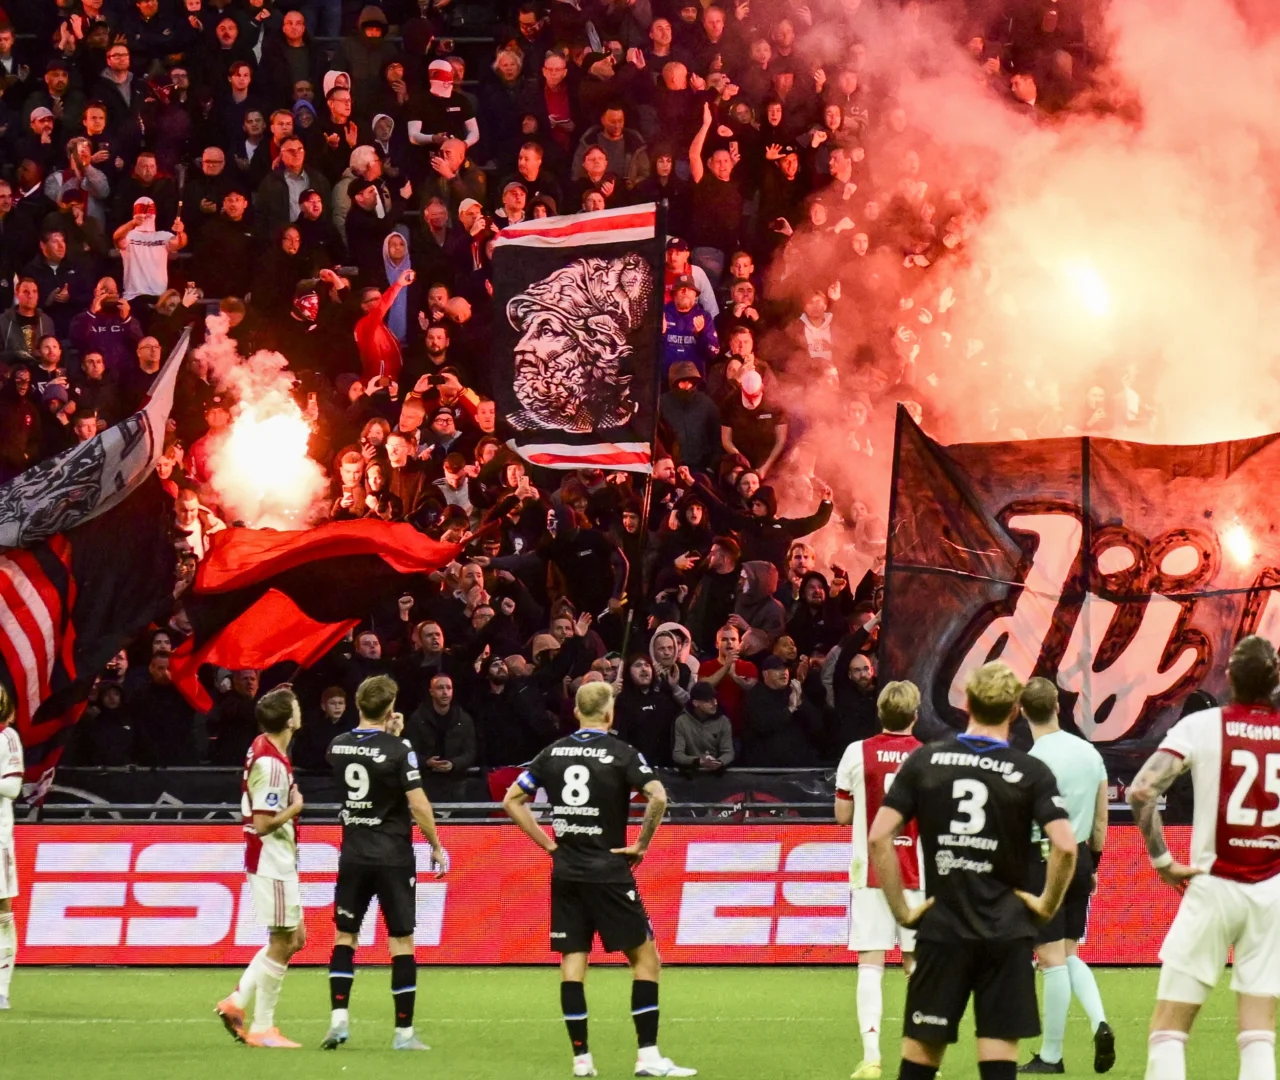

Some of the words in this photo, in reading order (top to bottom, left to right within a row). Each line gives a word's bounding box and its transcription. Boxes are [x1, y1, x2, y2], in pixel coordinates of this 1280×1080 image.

[876, 750, 909, 763] TAYLO
[345, 762, 370, 801] 9
[561, 764, 590, 807] 8
[346, 800, 373, 809] VENTE
[950, 778, 989, 835] 3
